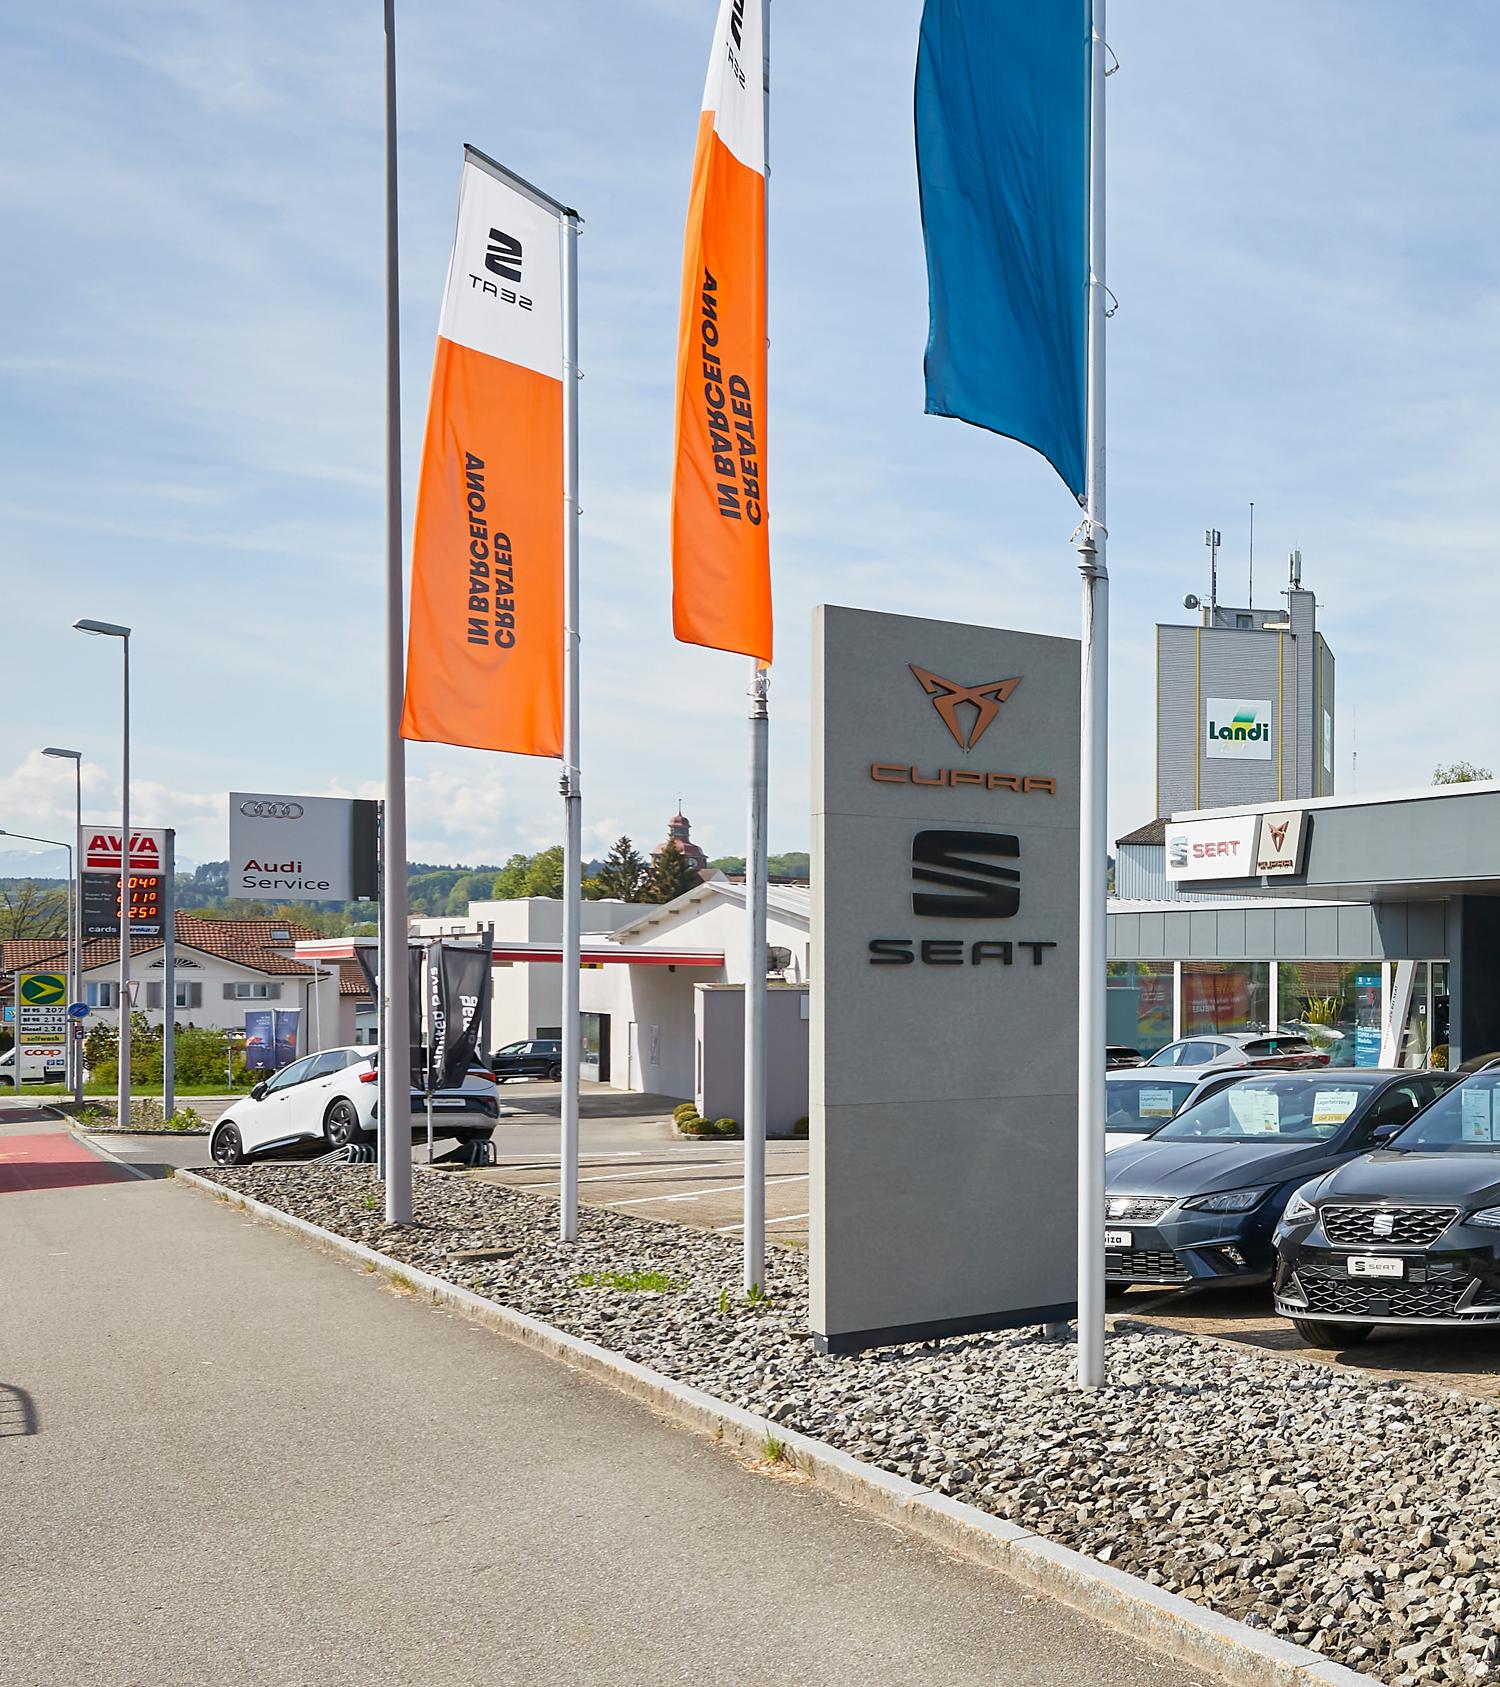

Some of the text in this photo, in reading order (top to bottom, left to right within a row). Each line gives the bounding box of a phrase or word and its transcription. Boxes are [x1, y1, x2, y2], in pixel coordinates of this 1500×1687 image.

[1209, 721, 1269, 741] Landi
[870, 762, 1057, 795] CUPRA
[1192, 840, 1240, 858] SEAT
[243, 859, 302, 873] Audi
[242, 875, 330, 891] Service
[88, 925, 117, 933] cards
[869, 939, 1057, 966] SEAT
[24, 1049, 62, 1057] coop
[1105, 1233, 1122, 1243] iza
